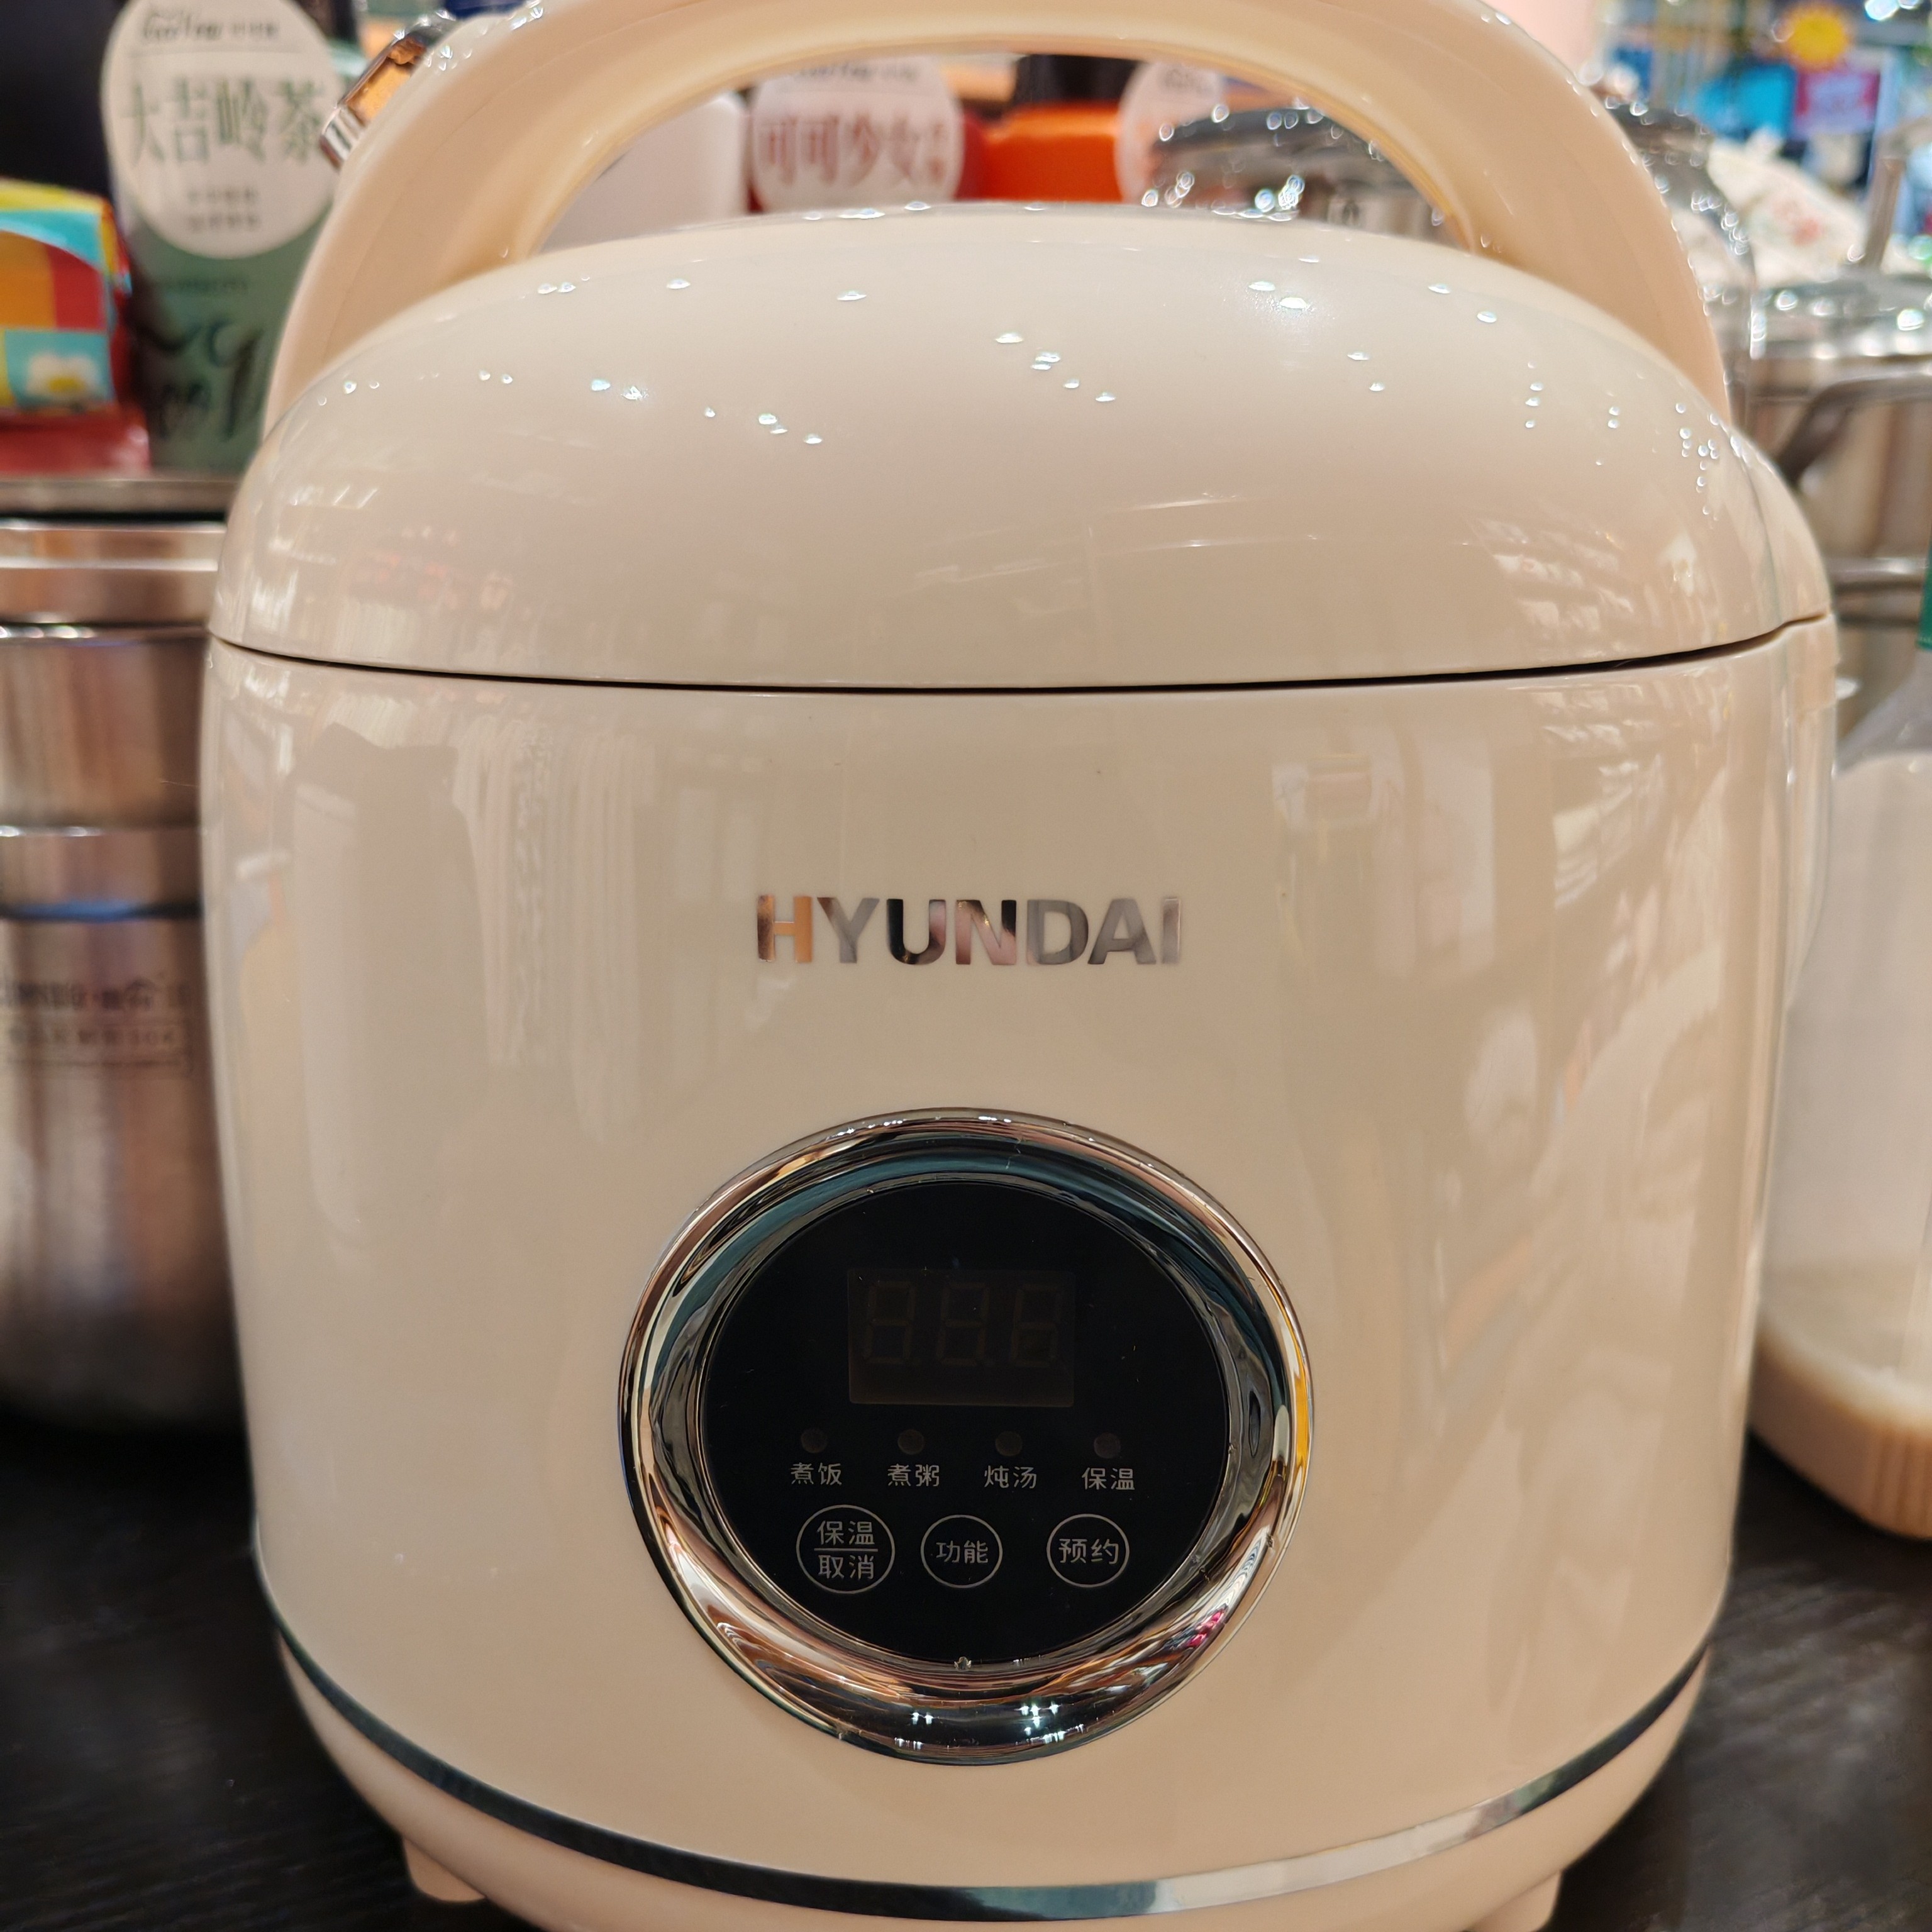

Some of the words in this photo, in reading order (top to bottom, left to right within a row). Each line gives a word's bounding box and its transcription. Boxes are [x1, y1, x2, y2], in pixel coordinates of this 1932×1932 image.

[757, 895, 1180, 965] HYUNDAI
[791, 1462, 842, 1485] 煮饭
[887, 1463, 940, 1487] 煮粥
[984, 1465, 1037, 1489] 炖汤
[1081, 1467, 1135, 1491] 保温
[817, 1520, 875, 1545] 保温
[936, 1540, 988, 1564] 功能
[1058, 1538, 1119, 1565] 预约
[817, 1555, 875, 1580] 取消
